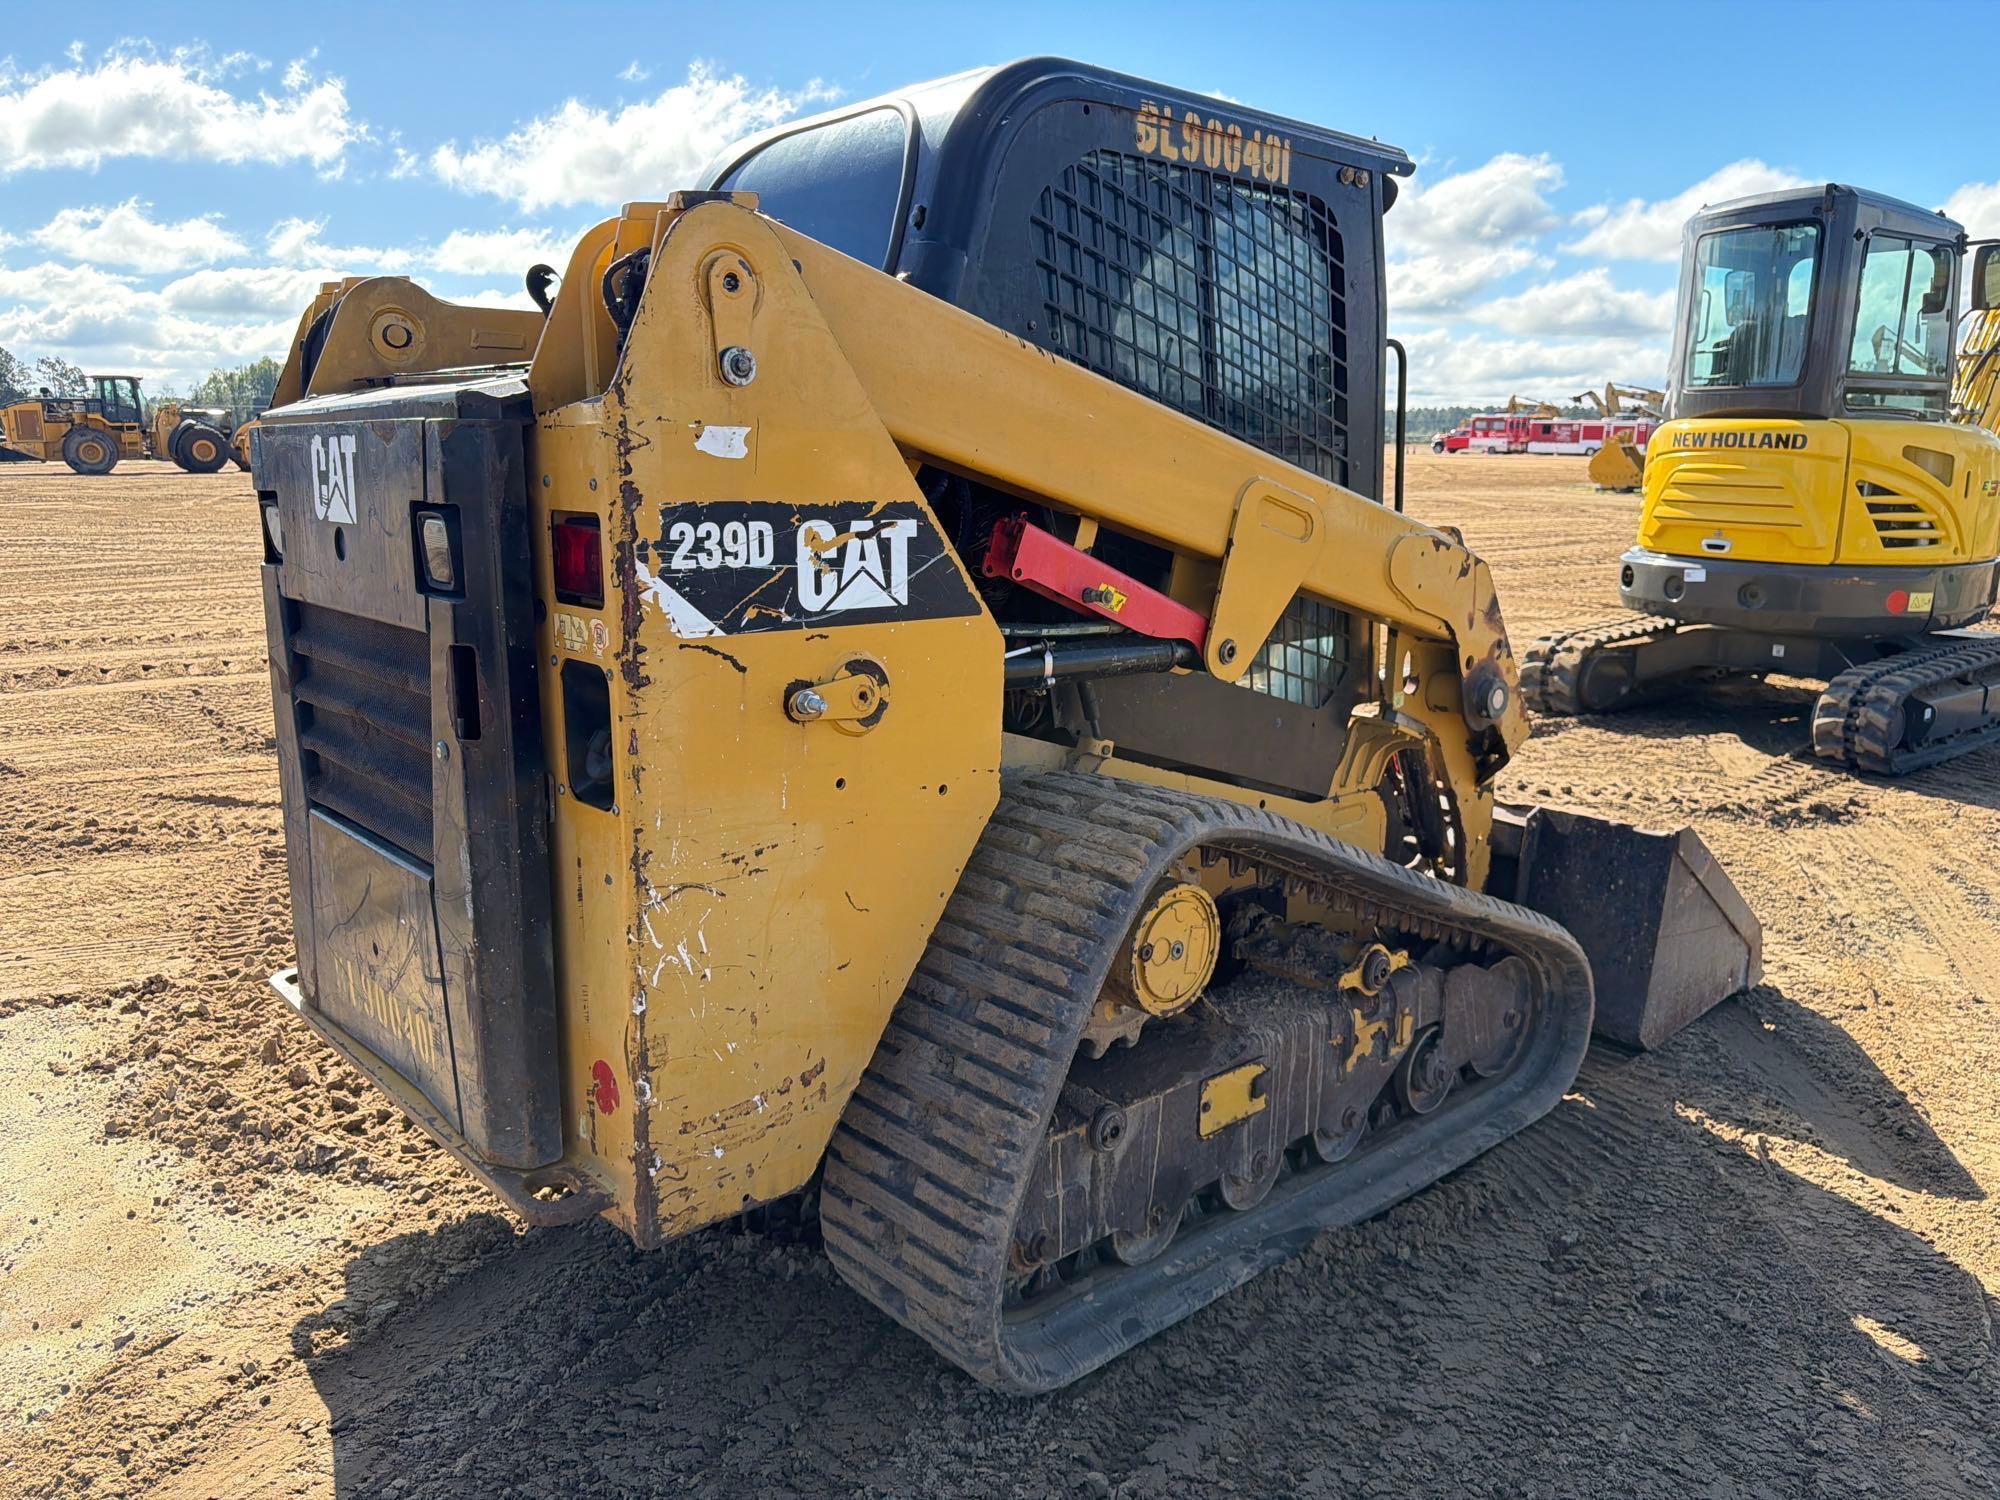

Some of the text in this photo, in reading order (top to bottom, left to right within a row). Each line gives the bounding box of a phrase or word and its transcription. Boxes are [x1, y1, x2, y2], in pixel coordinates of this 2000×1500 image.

[310, 433, 358, 525] CAT
[1672, 432, 1809, 450] NEW HOLLAND
[669, 518, 918, 612] 239D CAT
